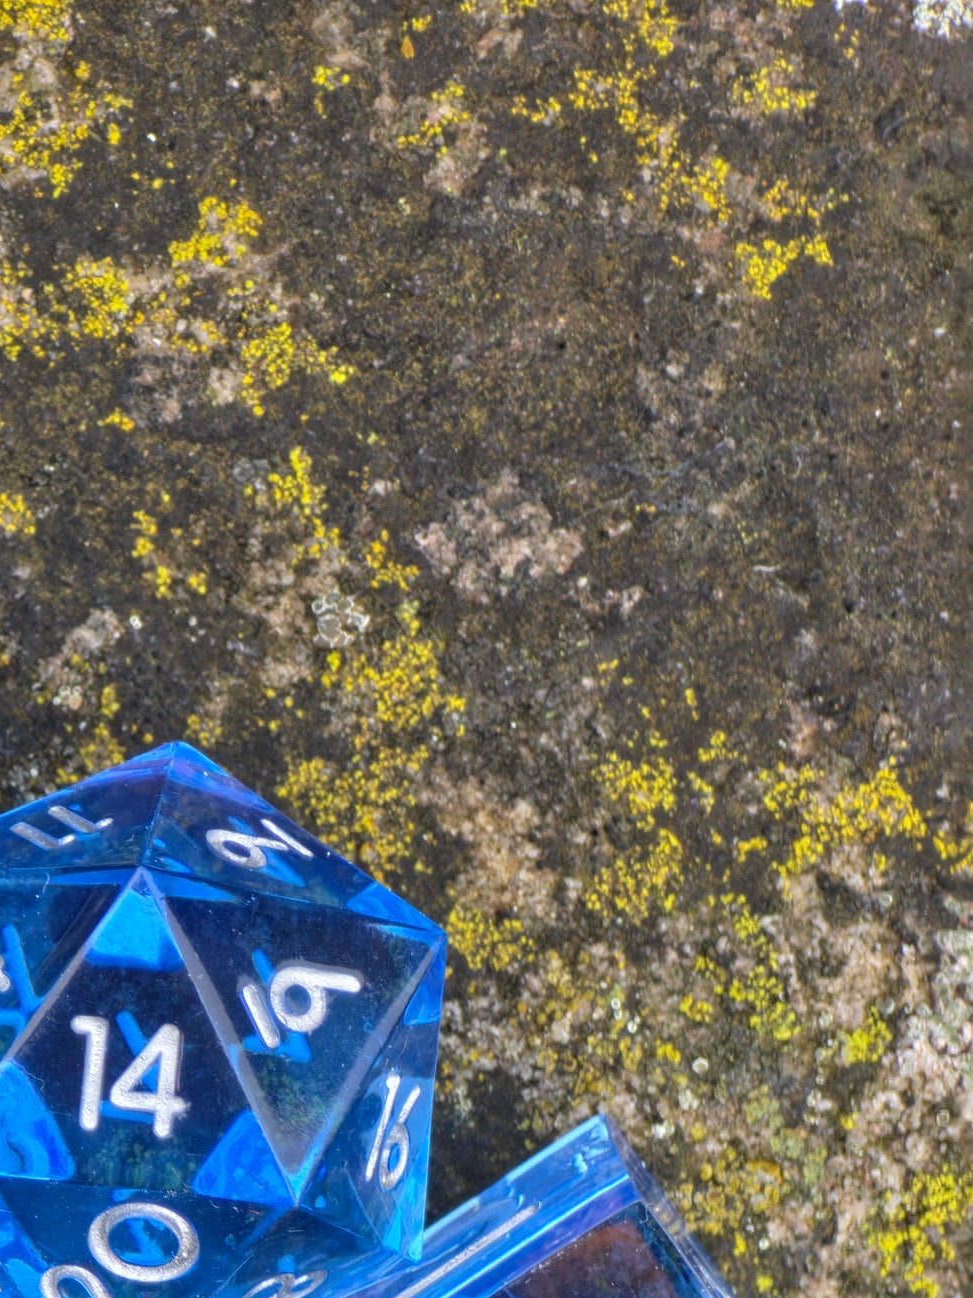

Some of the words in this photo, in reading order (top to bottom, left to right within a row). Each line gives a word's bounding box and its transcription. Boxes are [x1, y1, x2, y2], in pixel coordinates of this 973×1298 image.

[9, 805, 115, 851] 11
[70, 1014, 191, 1140] 14
[364, 1067, 421, 1192] 16
